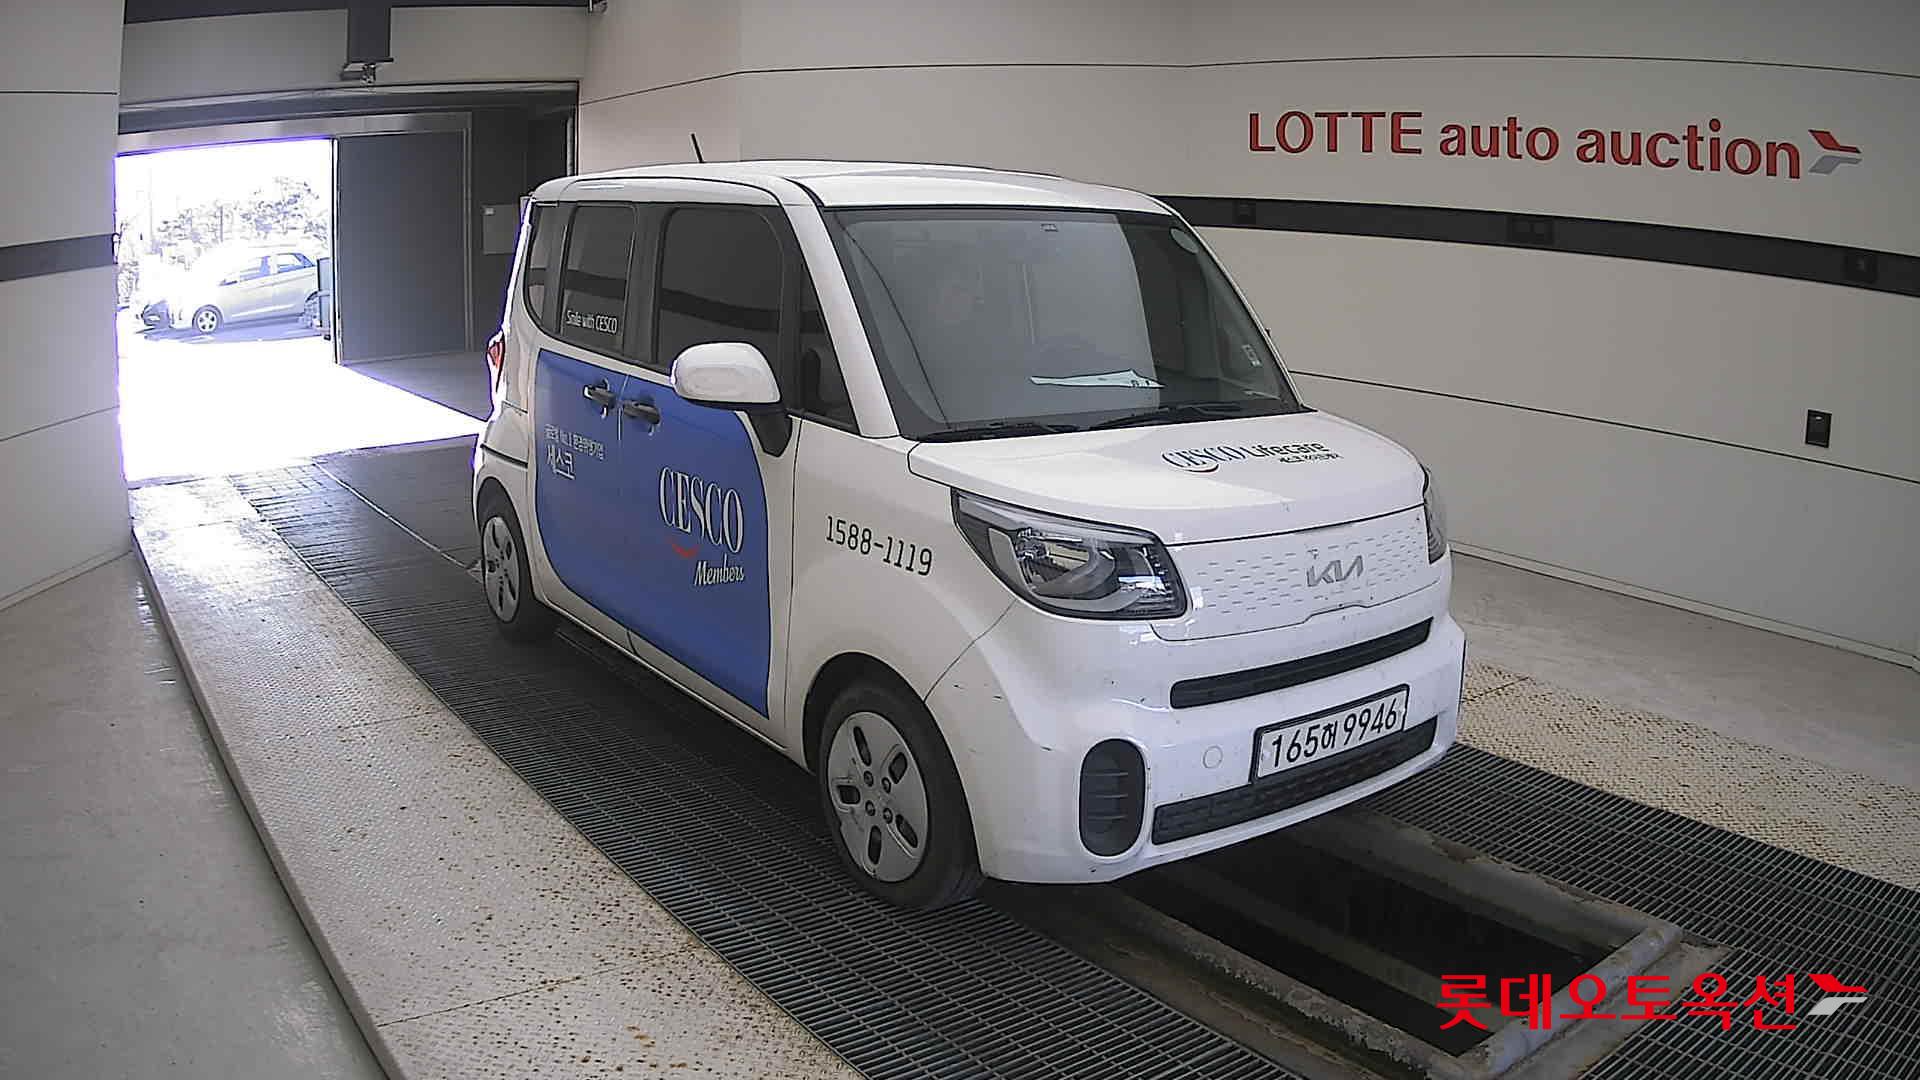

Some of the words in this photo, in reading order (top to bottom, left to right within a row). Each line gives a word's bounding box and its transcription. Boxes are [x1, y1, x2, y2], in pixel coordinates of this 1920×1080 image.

[1248, 111, 1423, 155] LOTTE
[1439, 116, 1560, 161] auto
[1575, 117, 1801, 179] auction
[595, 315, 617, 334] CESCO
[1161, 445, 1246, 468] CESCO
[1239, 443, 1329, 458] Lifecare
[659, 466, 744, 553] CESCO
[694, 552, 745, 586] Members
[826, 515, 933, 577] 1588-1119
[1342, 697, 1397, 746] 9946
